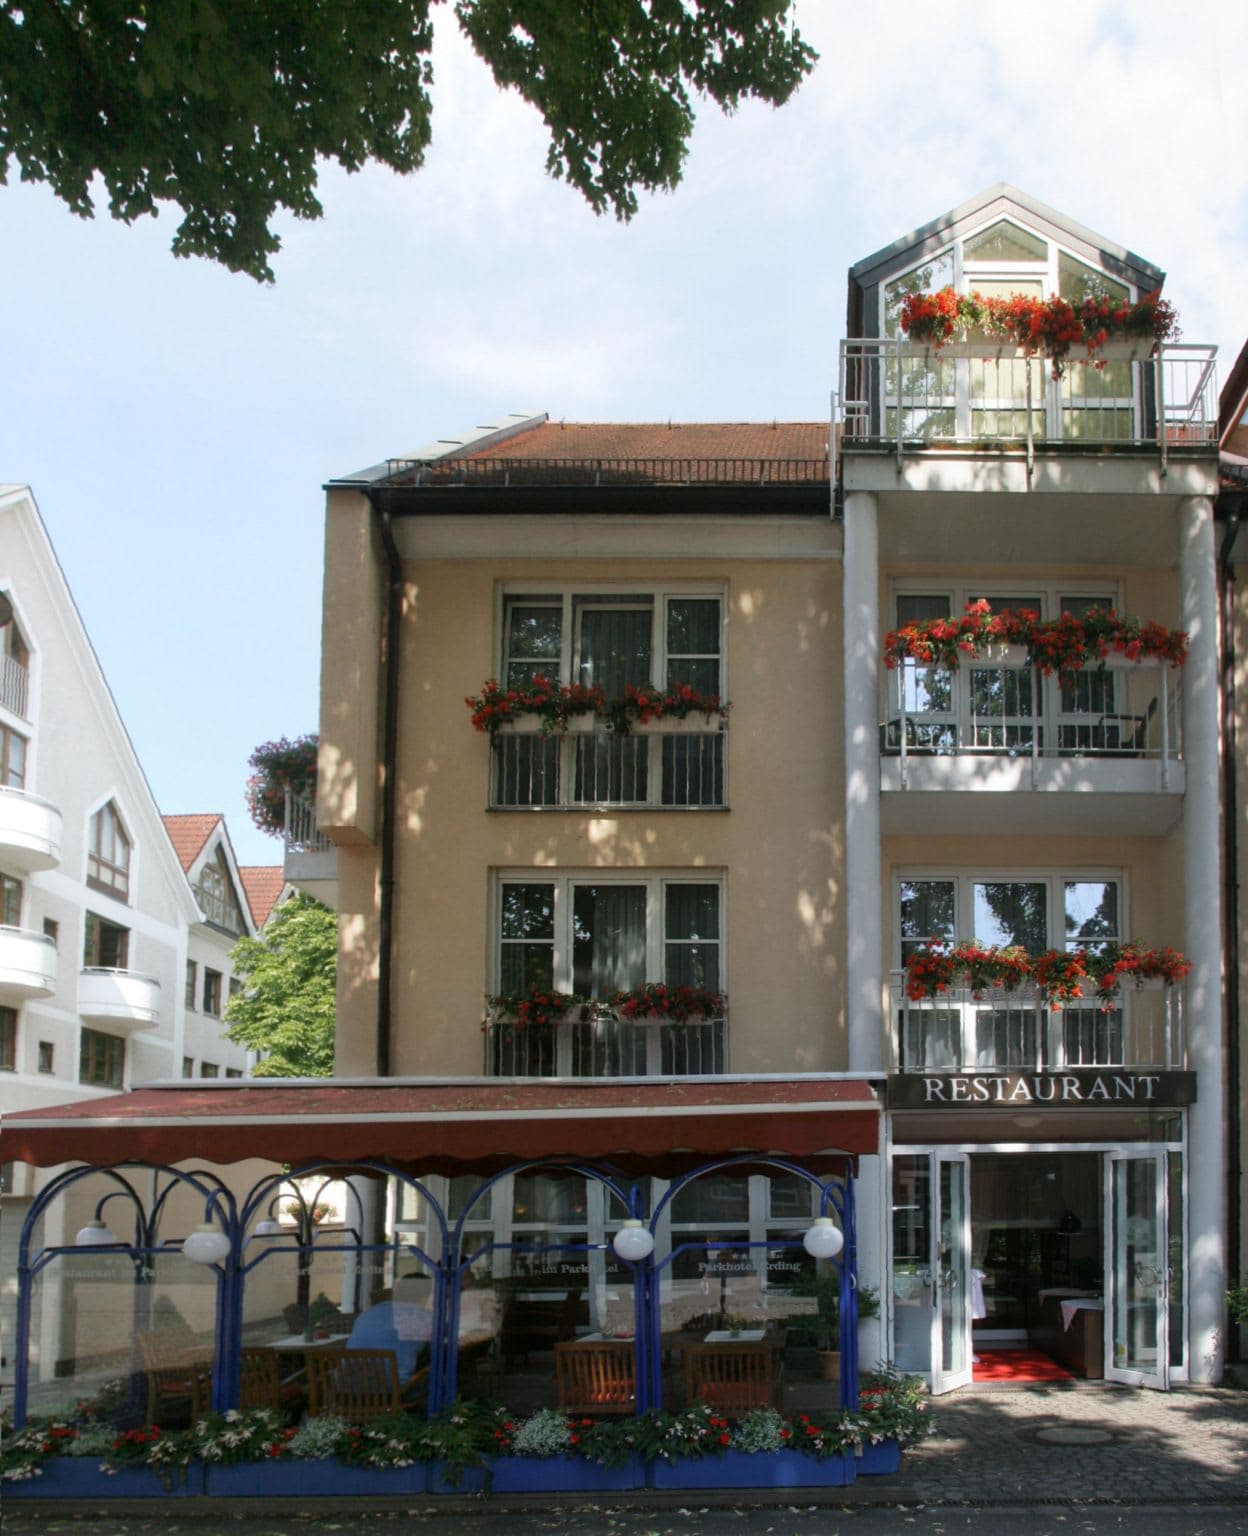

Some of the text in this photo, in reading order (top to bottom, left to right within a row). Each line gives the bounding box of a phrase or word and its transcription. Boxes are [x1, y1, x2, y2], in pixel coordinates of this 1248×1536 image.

[924, 1076, 1161, 1102] RESTAURANT
[561, 1263, 619, 1274] Parkel
[697, 1261, 757, 1272] Parkhotel
